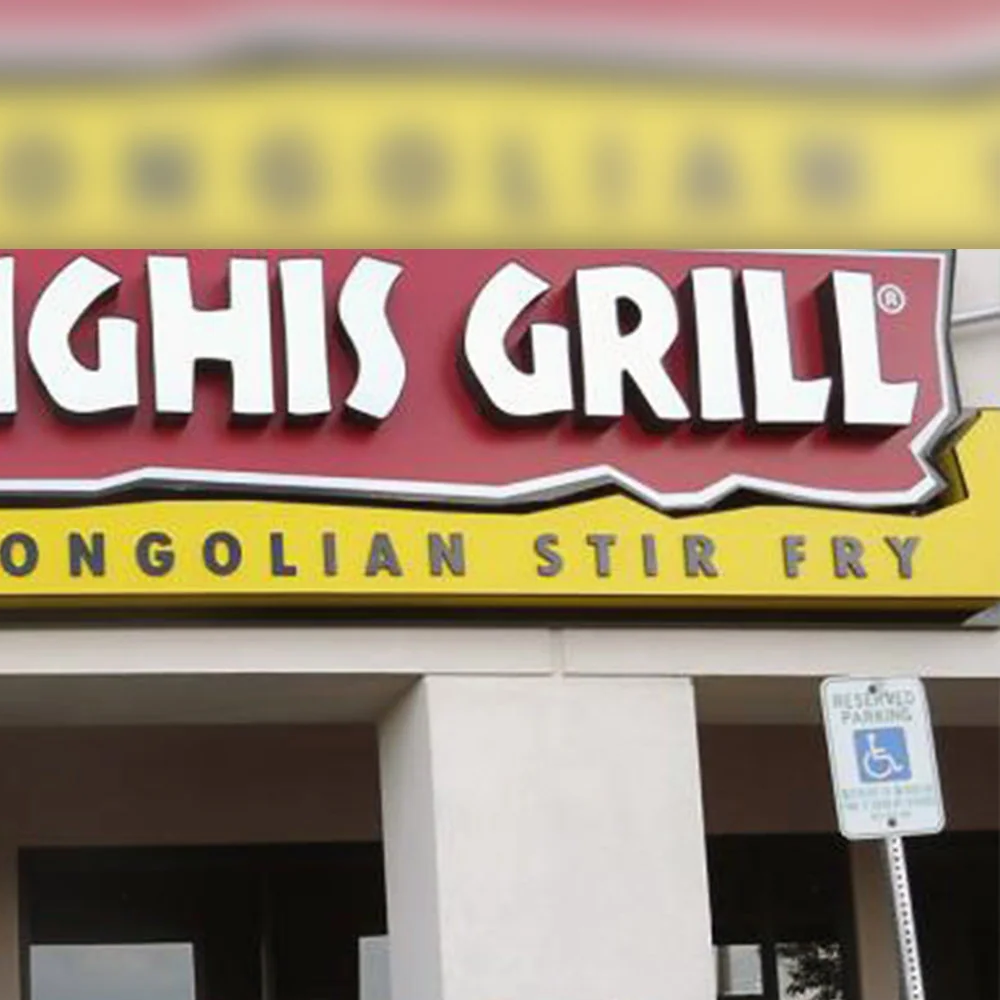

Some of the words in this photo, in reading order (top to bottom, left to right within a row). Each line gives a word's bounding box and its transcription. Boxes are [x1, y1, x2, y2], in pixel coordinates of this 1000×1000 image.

[464, 261, 918, 425] GRILL
[536, 535, 718, 578] STIR
[782, 536, 921, 579] FRY
[832, 690, 916, 709] RESERVED
[841, 707, 913, 725] PARKING
